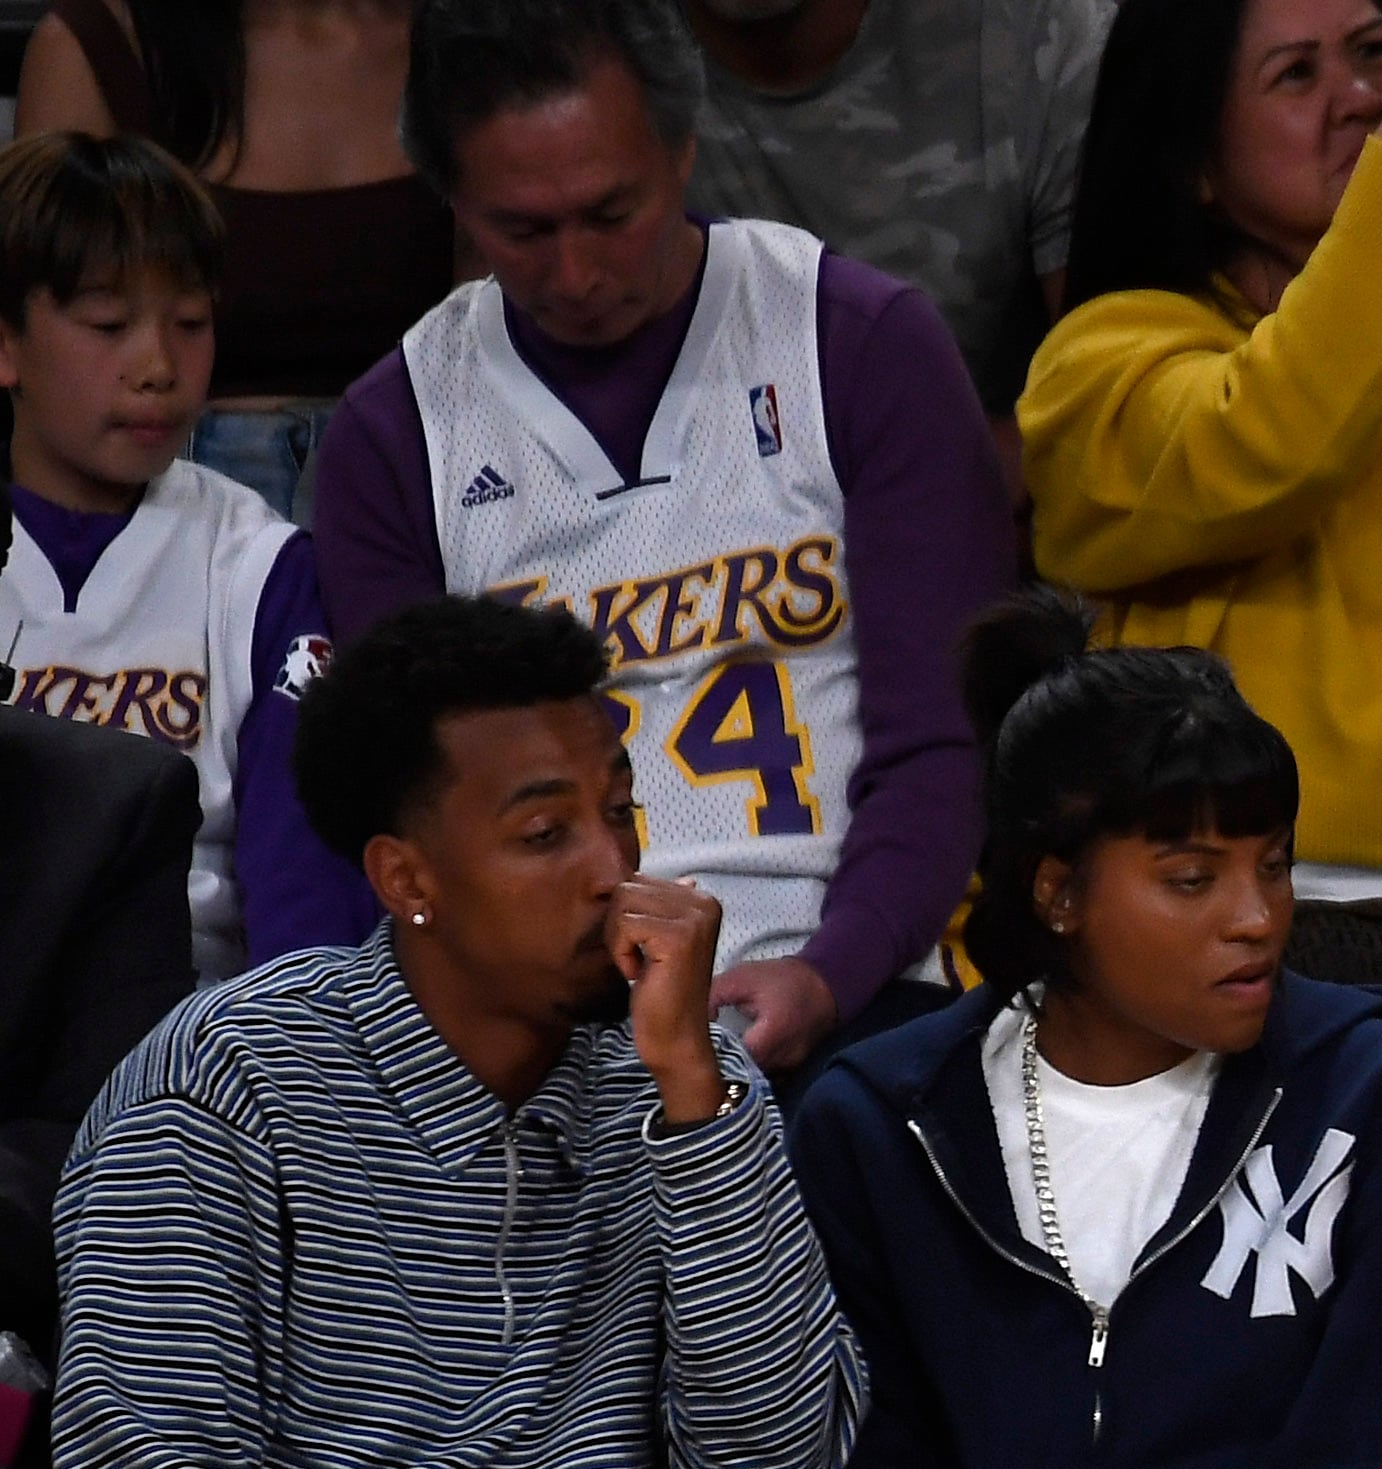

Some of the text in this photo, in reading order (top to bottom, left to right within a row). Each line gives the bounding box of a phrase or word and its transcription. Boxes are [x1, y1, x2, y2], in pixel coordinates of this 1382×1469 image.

[461, 484, 515, 509] adidas
[485, 533, 849, 671] KERS
[1200, 1128, 1357, 1319] NY
